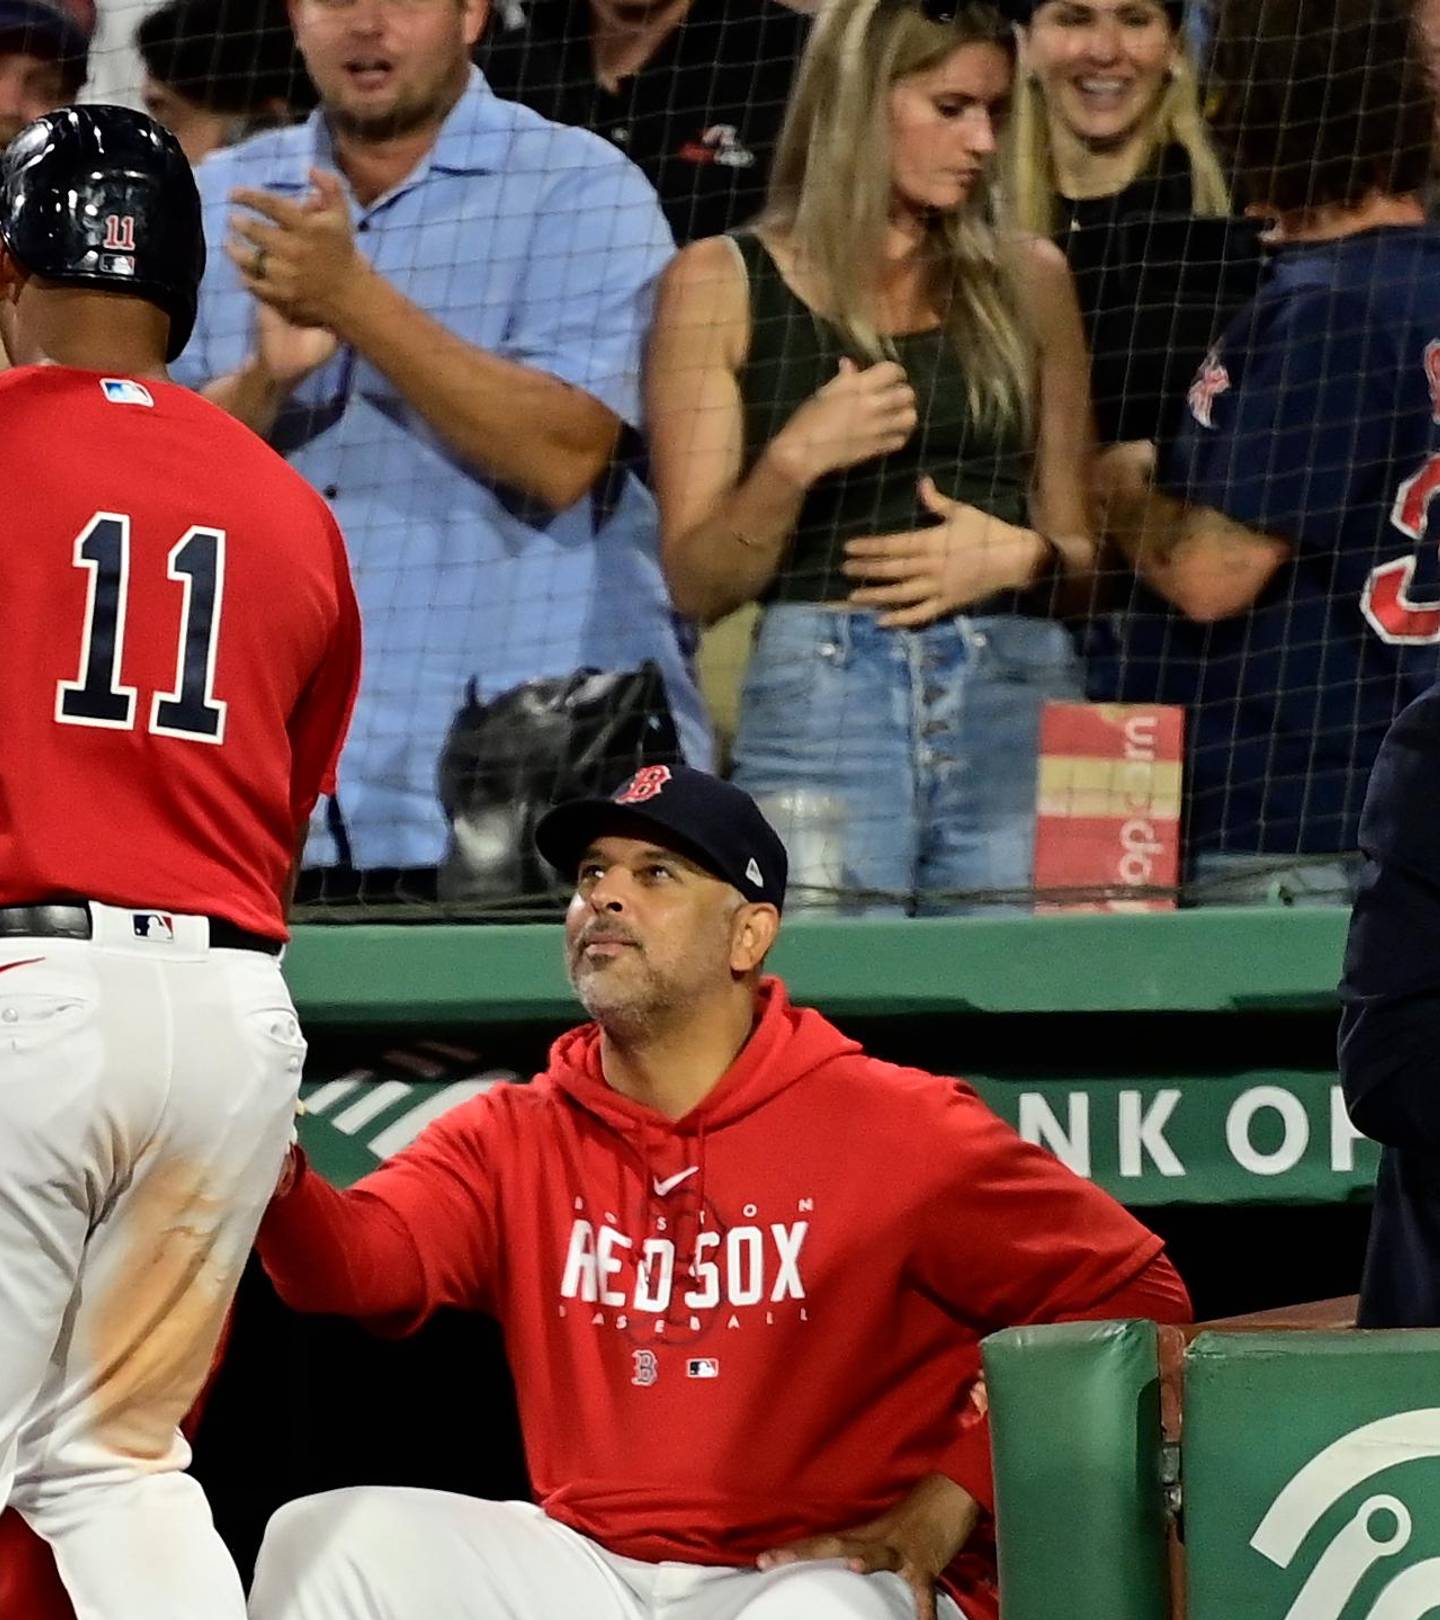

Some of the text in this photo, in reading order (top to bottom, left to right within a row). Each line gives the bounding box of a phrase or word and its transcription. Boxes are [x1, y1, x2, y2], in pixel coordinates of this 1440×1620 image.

[103, 214, 136, 251] 11
[55, 510, 228, 746] 11
[615, 764, 673, 804] B
[560, 1218, 809, 1313] RED SOX
[631, 1349, 658, 1387] B
